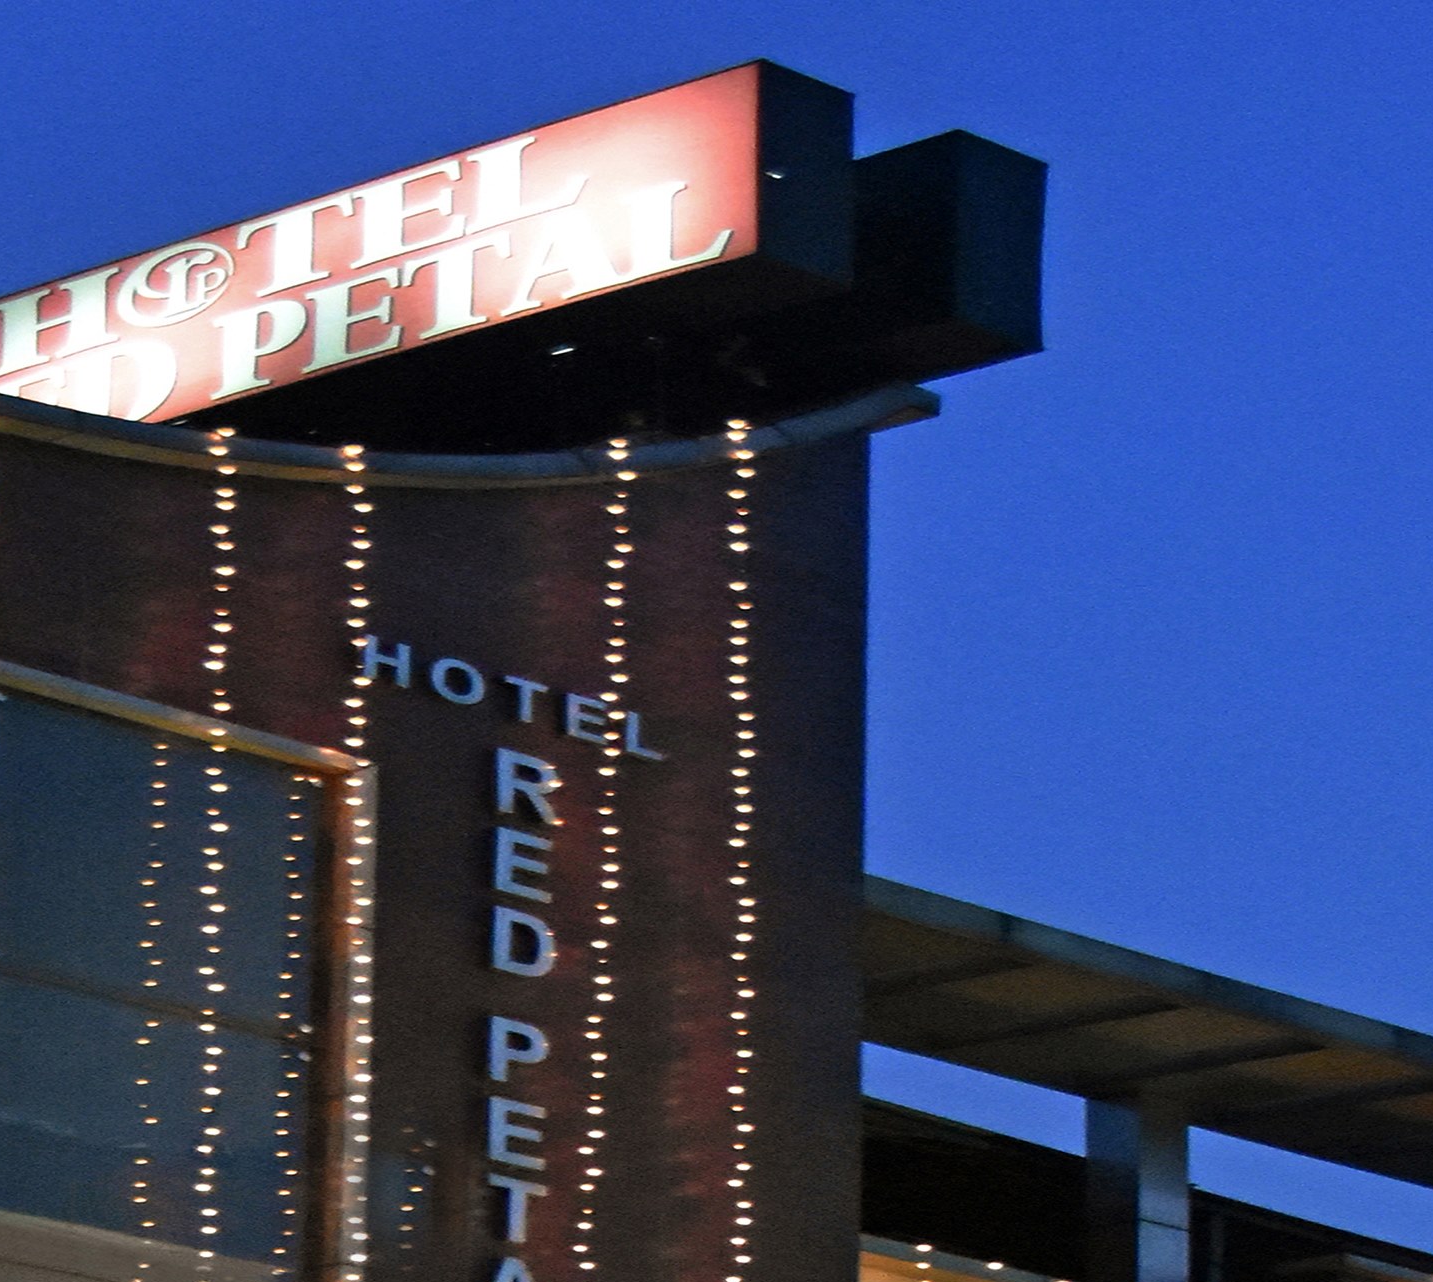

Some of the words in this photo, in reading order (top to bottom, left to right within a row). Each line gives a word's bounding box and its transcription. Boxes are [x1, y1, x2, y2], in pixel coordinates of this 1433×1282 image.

[210, 181, 735, 400] PETAL
[363, 635, 666, 761] HOTEL
[492, 748, 563, 978] RED
